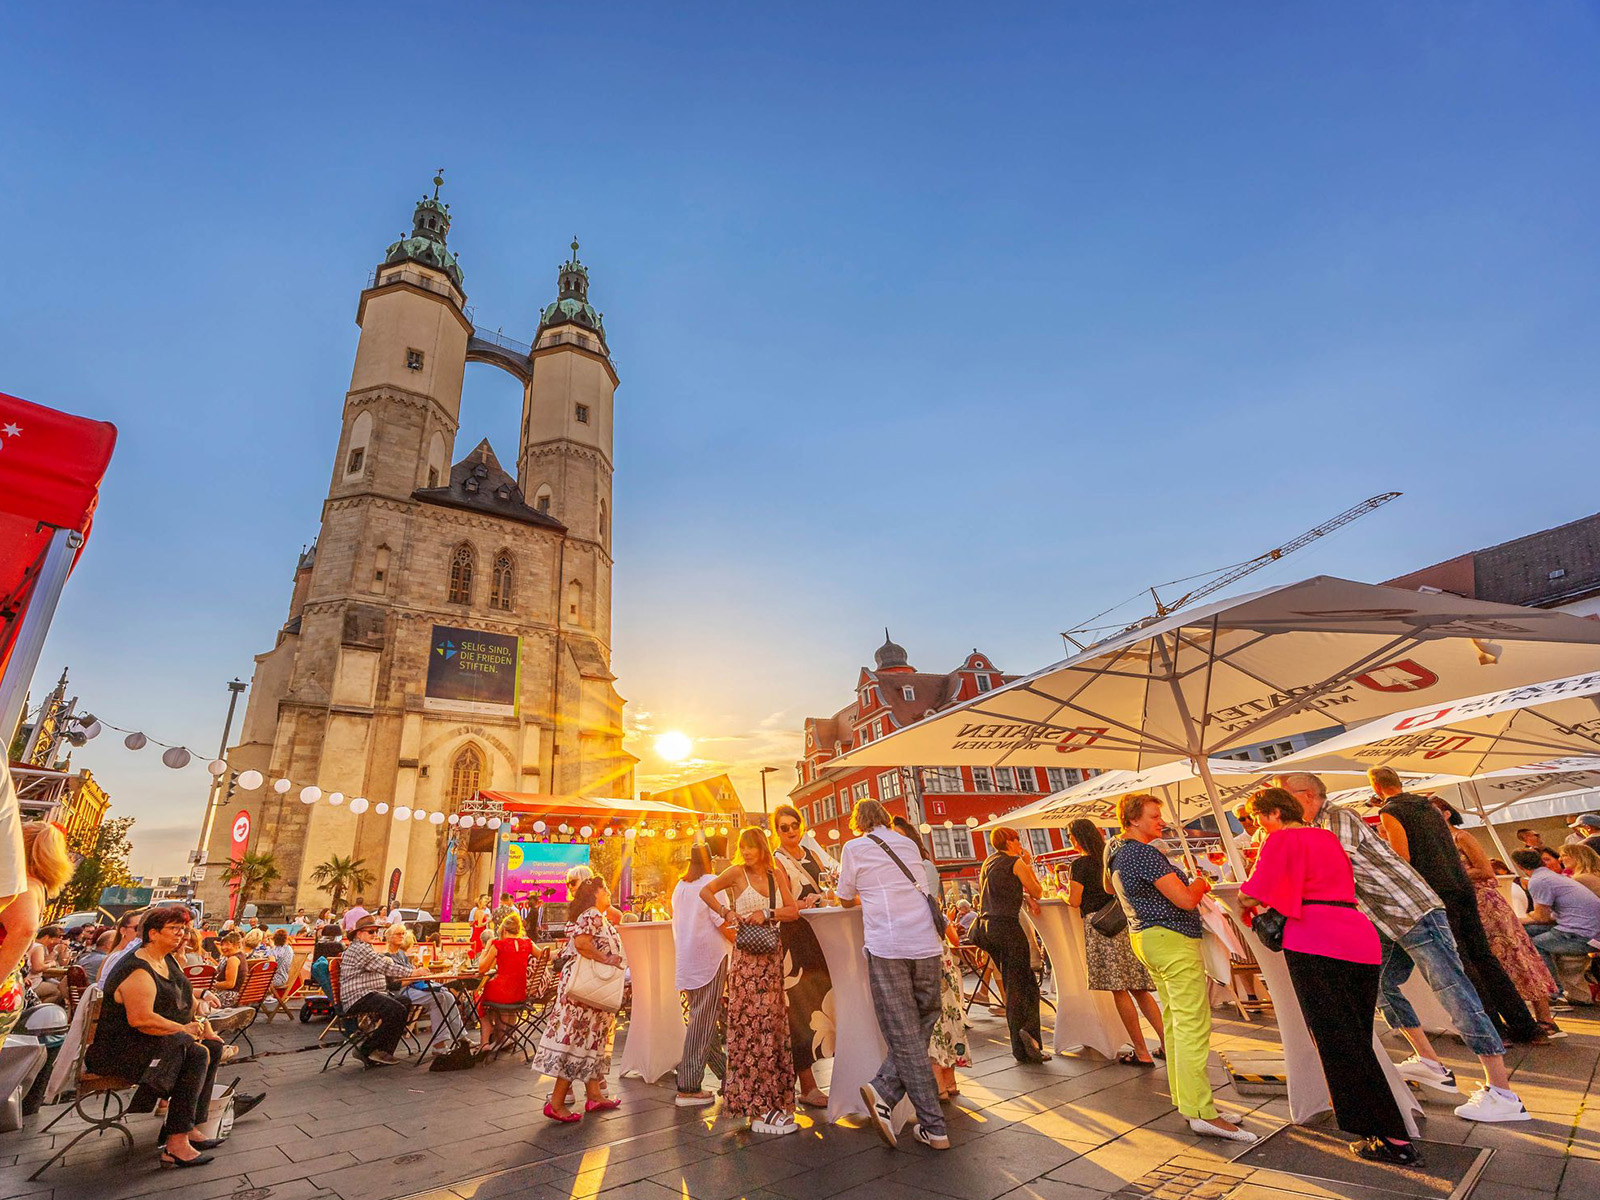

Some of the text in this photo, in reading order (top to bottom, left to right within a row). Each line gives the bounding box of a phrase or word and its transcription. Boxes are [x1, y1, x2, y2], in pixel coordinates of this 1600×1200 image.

[461, 641, 511, 656] SELIG SIND,
[460, 651, 512, 665] DIE FRIEDEN
[459, 661, 499, 673] STIFTEN.
